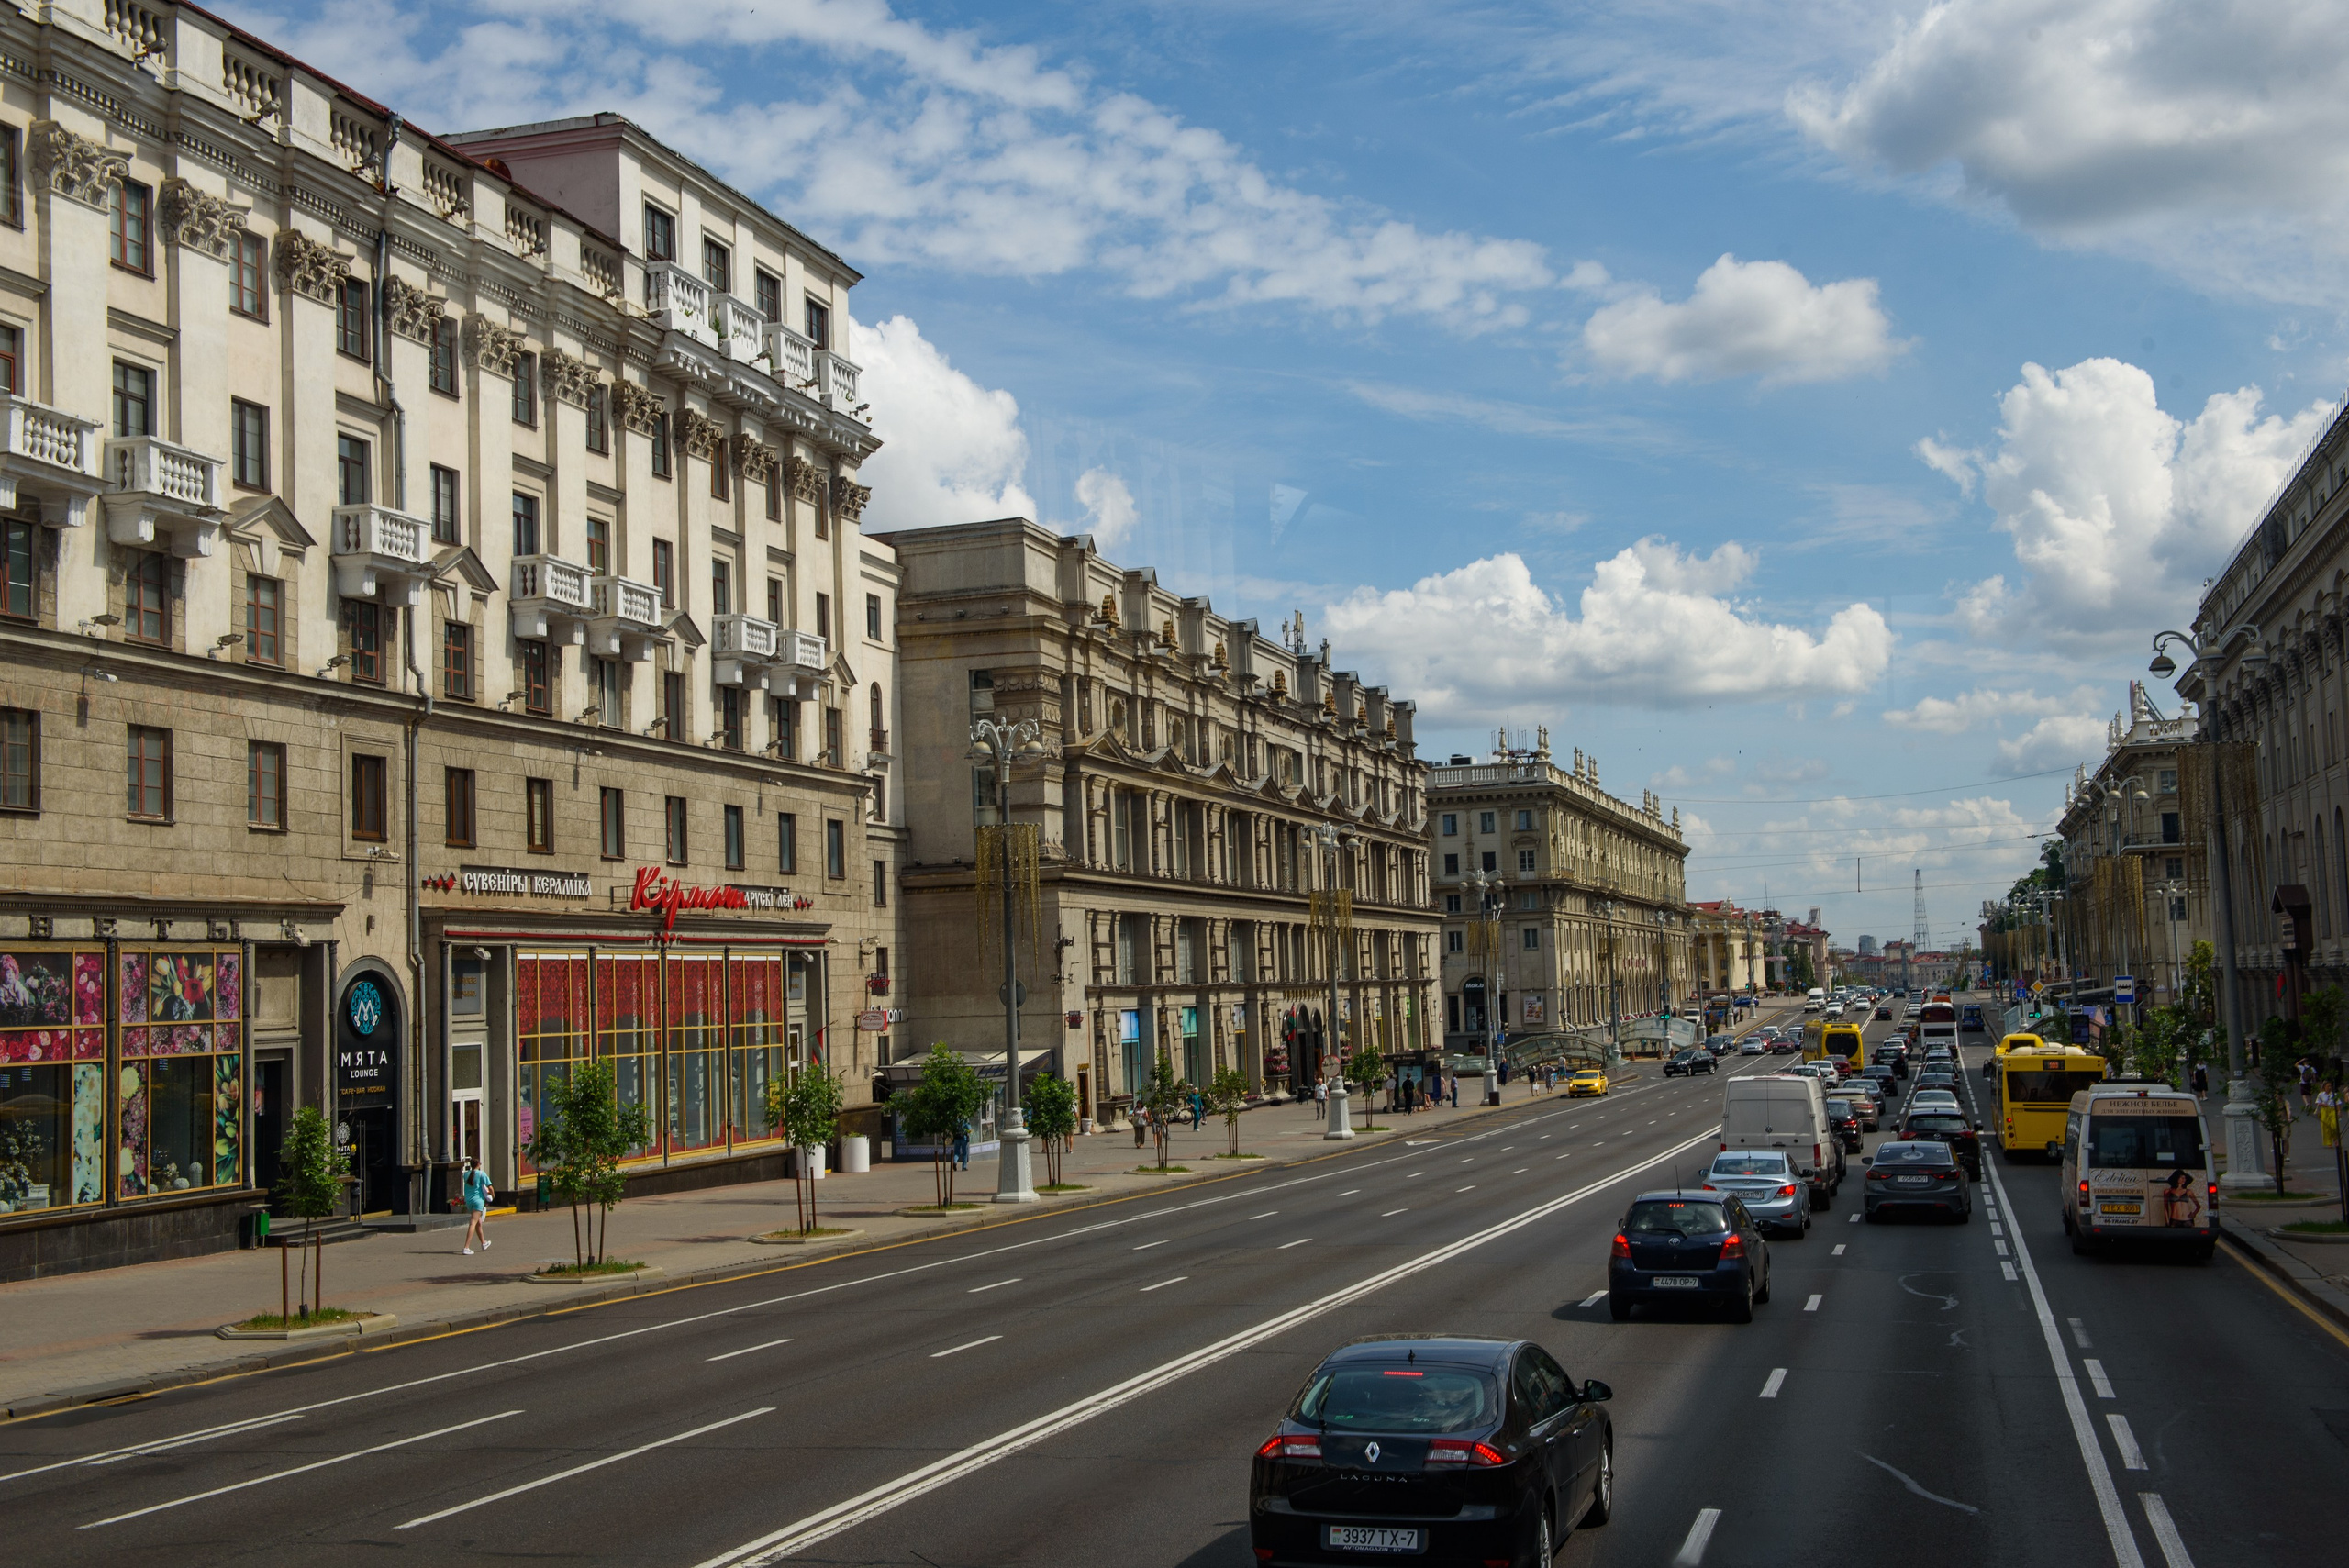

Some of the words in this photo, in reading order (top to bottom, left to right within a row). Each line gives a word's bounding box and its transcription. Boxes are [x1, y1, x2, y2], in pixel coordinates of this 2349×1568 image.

[463, 868, 528, 895] СУВЕНІРЫ
[534, 873, 593, 896] КЕРАМІКА
[630, 866, 748, 930] Кірмаш
[743, 887, 774, 910] АРУСКІ
[29, 913, 241, 940] ВЕТЫ
[340, 1051, 388, 1067] МЯТА
[351, 1068, 379, 1079] LOUNGE
[2110, 1100, 2149, 1108] НЕЖНОЕ
[2151, 1100, 2178, 1108] БЕЛЬЕ
[1660, 1278, 1677, 1286] 4470
[1340, 1473, 1408, 1484] LAGUNA
[1342, 1528, 1375, 1545] 3937
[1378, 1529, 1415, 1547] TX-7
